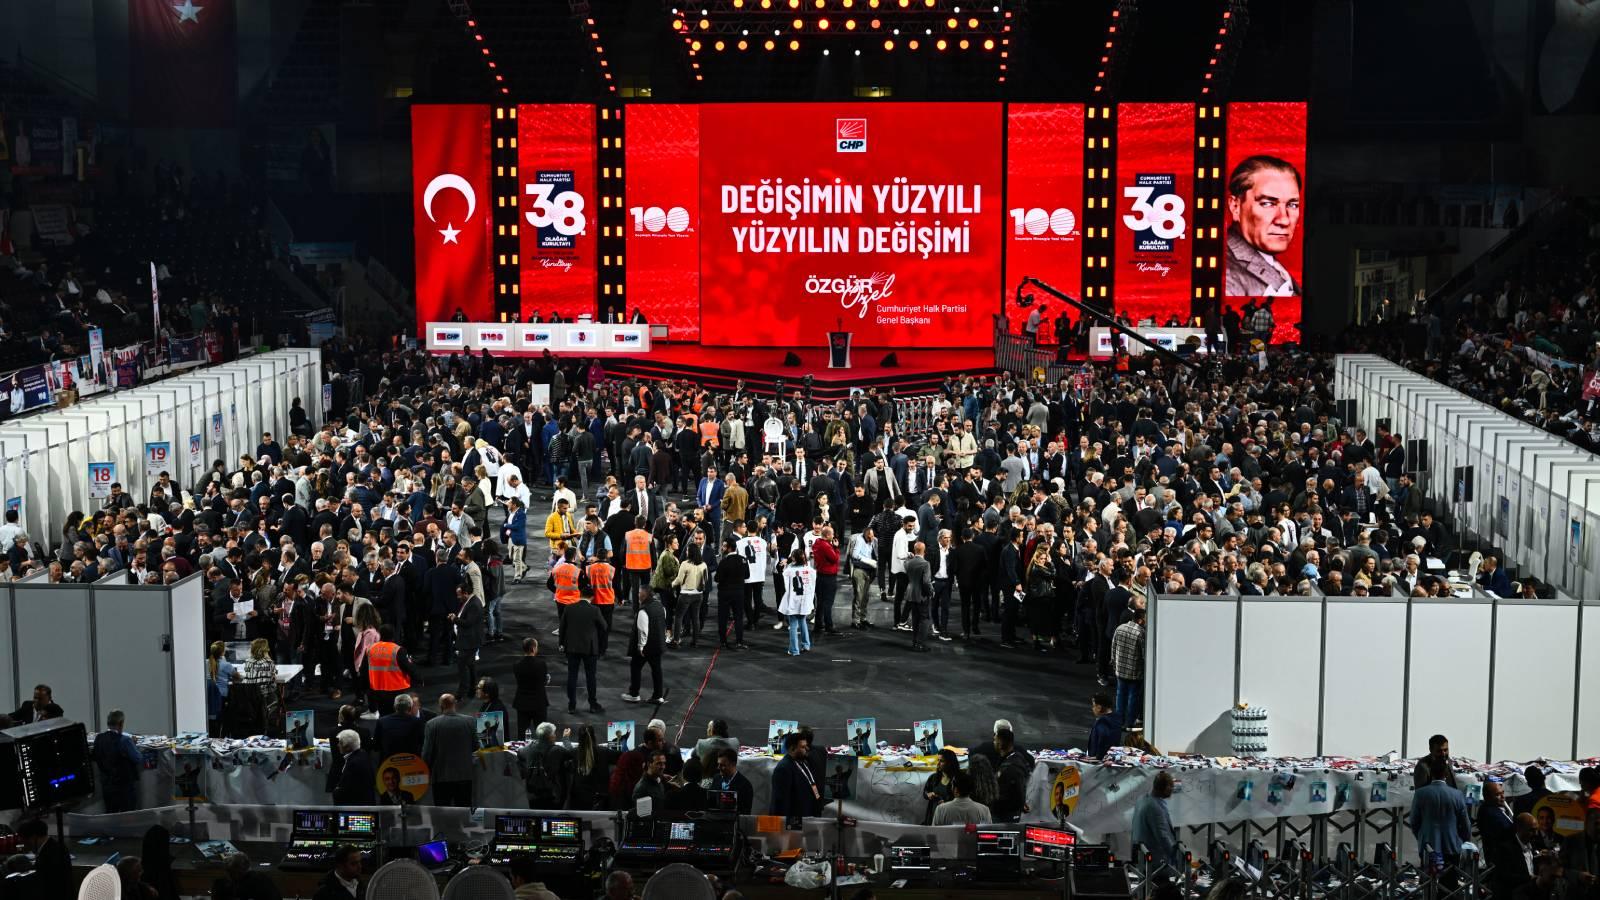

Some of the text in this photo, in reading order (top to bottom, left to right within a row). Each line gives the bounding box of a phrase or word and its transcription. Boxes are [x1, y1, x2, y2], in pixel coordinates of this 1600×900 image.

[839, 140, 864, 150] CHP
[721, 176, 981, 220] DEĞİŞİMİN YÜZYILI
[629, 206, 690, 233] 100
[1009, 207, 1076, 236] 100
[731, 219, 970, 260] YÜZYILIN DEĞİŞİMİ
[805, 274, 873, 294] ÖZGÜR
[876, 304, 967, 314] Cumhuriyet Halk Partisi
[876, 316, 931, 325] Genel Başkanı
[150, 447, 166, 460] 19
[93, 467, 111, 482] 18
